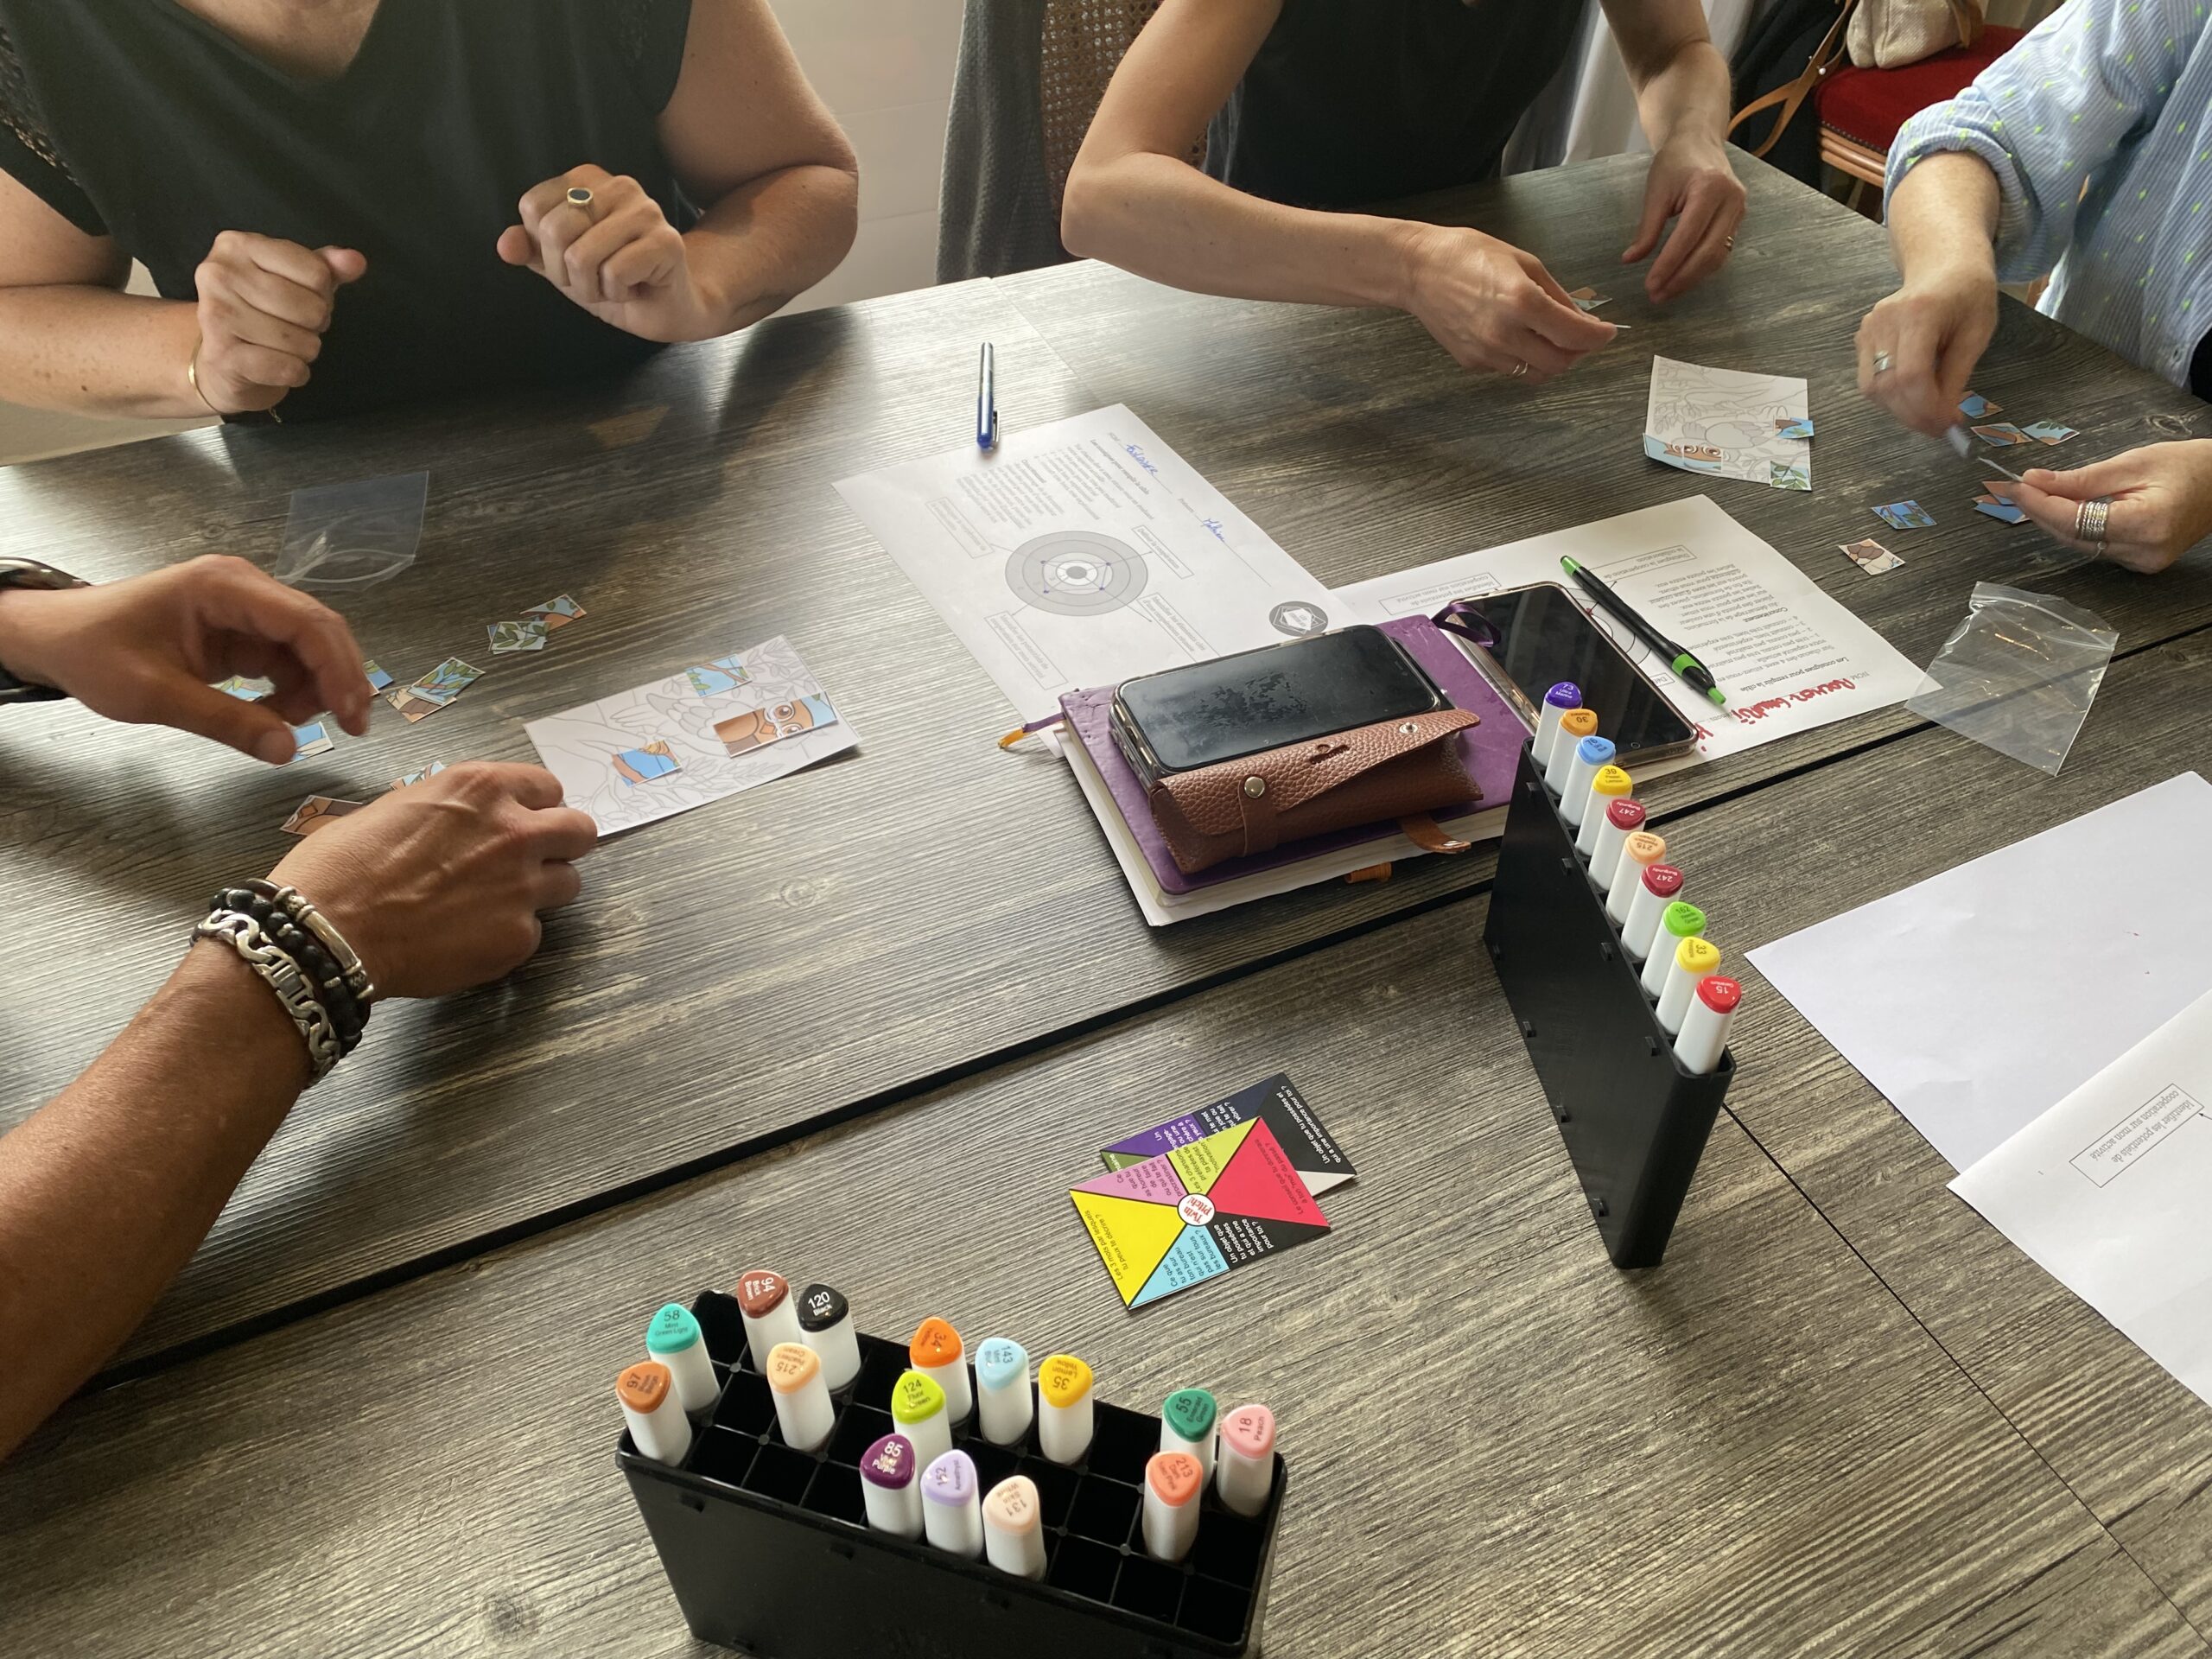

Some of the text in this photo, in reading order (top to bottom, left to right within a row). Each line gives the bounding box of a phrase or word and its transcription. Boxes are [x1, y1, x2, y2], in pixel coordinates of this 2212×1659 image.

[1617, 802, 1641, 811] Burgundy
[1619, 808, 1635, 817] 247
[1637, 842, 1653, 851] 215
[1652, 867, 1678, 876] Burgundy
[1656, 874, 1673, 883] 247
[1675, 906, 1691, 914] 162
[1695, 944, 1707, 955] 33
[1716, 986, 1729, 995] 15
[1216, 1103, 1225, 1114] fait
[1281, 1097, 1302, 1122] possèdes
[1290, 1096, 1303, 1109] pour
[1200, 1110, 1211, 1122] met
[1214, 1115, 1225, 1126] joie
[1228, 1106, 1241, 1121] vibrer
[1188, 1122, 1201, 1136] yeux
[1299, 1109, 1322, 1138] importance
[2089, 1090, 2178, 1160] coopération sur mon activité
[2111, 1099, 2194, 1162] Identifier les potentiels de
[1154, 1131, 1162, 1141] Un
[1170, 1125, 1185, 1144] ou une
[1303, 1128, 1313, 1140] que
[1310, 1139, 1324, 1154] objet
[1320, 1137, 1331, 1149] une
[1174, 1148, 1192, 1176] chansons
[1321, 1154, 1330, 1164] Un
[1331, 1153, 1341, 1163] qui
[1193, 1181, 1202, 1193] Les
[1186, 1196, 1211, 1215] Pitch!
[1084, 1210, 1100, 1235] lesquels
[1184, 1206, 1201, 1224] Twin
[1098, 1218, 1113, 1239] décrire
[1231, 1220, 1242, 1232] une
[1096, 1236, 1107, 1246] par
[1223, 1222, 1243, 1251] possèdes
[1241, 1218, 1263, 1252] importance
[1241, 1237, 1251, 1249] qui
[1255, 1225, 1274, 1249] pour toi
[1198, 1234, 1221, 1269] les bureaux
[1213, 1224, 1238, 1263] Un objet que
[1103, 1246, 1114, 1262] mots
[1114, 1247, 1126, 1262] peux
[1169, 1256, 1178, 1267] sur
[1189, 1236, 1214, 1273] pas sur tous
[1174, 1247, 1195, 1280] ton bureau
[1175, 1267, 1183, 1275] as
[1185, 1250, 1205, 1276] qui n'est
[1113, 1268, 1122, 1280] Les
[1162, 1263, 1178, 1287] Ce que
[745, 1281, 754, 1300] Brown
[753, 1280, 761, 1296] Brick
[761, 1277, 776, 1293] 94
[808, 1291, 830, 1309] 120
[664, 1310, 680, 1322] 58
[813, 1304, 832, 1316] Black
[931, 1332, 947, 1348] 34
[1001, 1345, 1014, 1363] 143
[776, 1362, 797, 1376] 215
[1052, 1366, 1077, 1379] Lemon
[1057, 1359, 1077, 1370] Yellow
[626, 1372, 641, 1389] 97
[903, 1379, 922, 1393] 124
[1052, 1376, 1071, 1390] 35
[1176, 1396, 1192, 1414] 55
[1196, 1403, 1209, 1423] Green
[1239, 1417, 1252, 1433] 18
[1254, 1416, 1265, 1441] Peach
[884, 1440, 904, 1458] 85
[872, 1459, 896, 1475] Purple
[1175, 1457, 1194, 1478] 213
[935, 1466, 947, 1487] 152
[1006, 1499, 1027, 1517] 131
